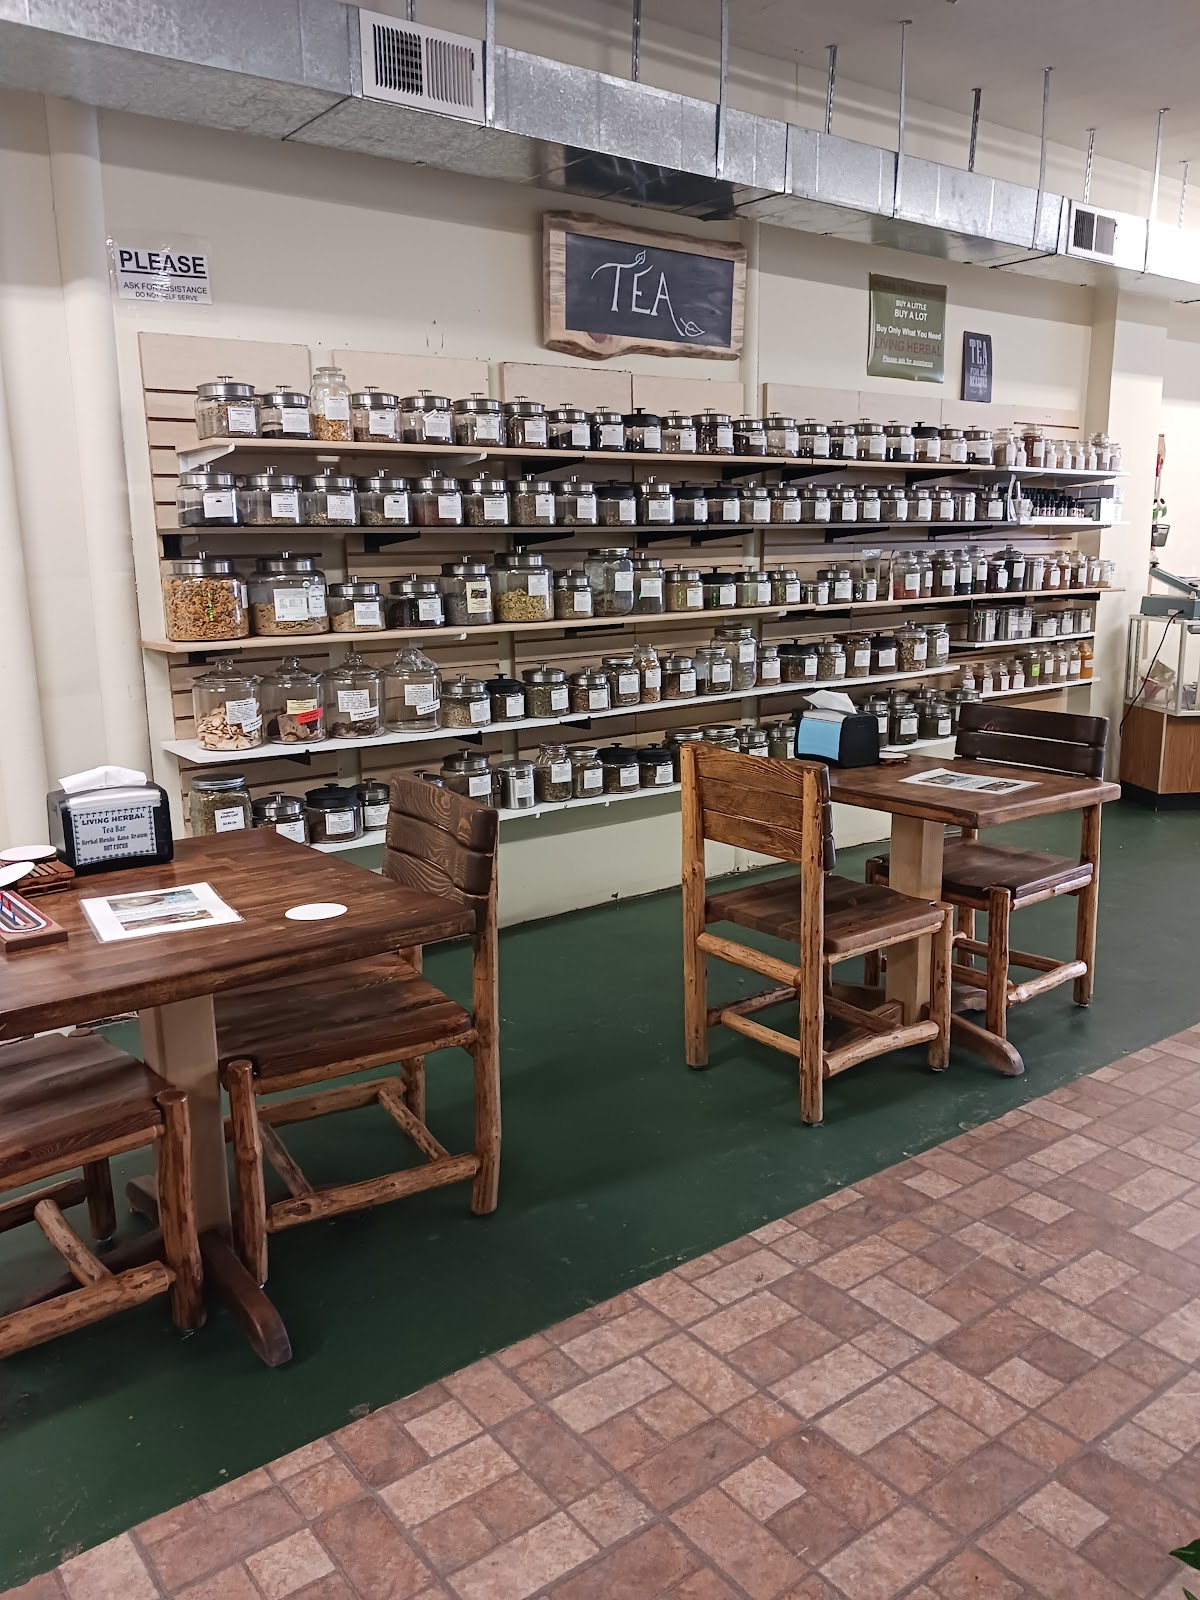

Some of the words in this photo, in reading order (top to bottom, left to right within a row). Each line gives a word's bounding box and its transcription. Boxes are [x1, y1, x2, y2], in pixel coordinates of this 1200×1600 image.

[120, 251, 206, 274] PLEASE
[160, 285, 208, 294] ASSISTANCE
[591, 257, 685, 337] TEA
[895, 309, 908, 318] BUY
[877, 324, 888, 334] Buy
[889, 326, 900, 336] Only
[902, 328, 916, 336] What
[917, 330, 928, 338] You
[875, 338, 904, 352] LIVING
[908, 342, 942, 356] HERBAL
[970, 339, 988, 364] TEA
